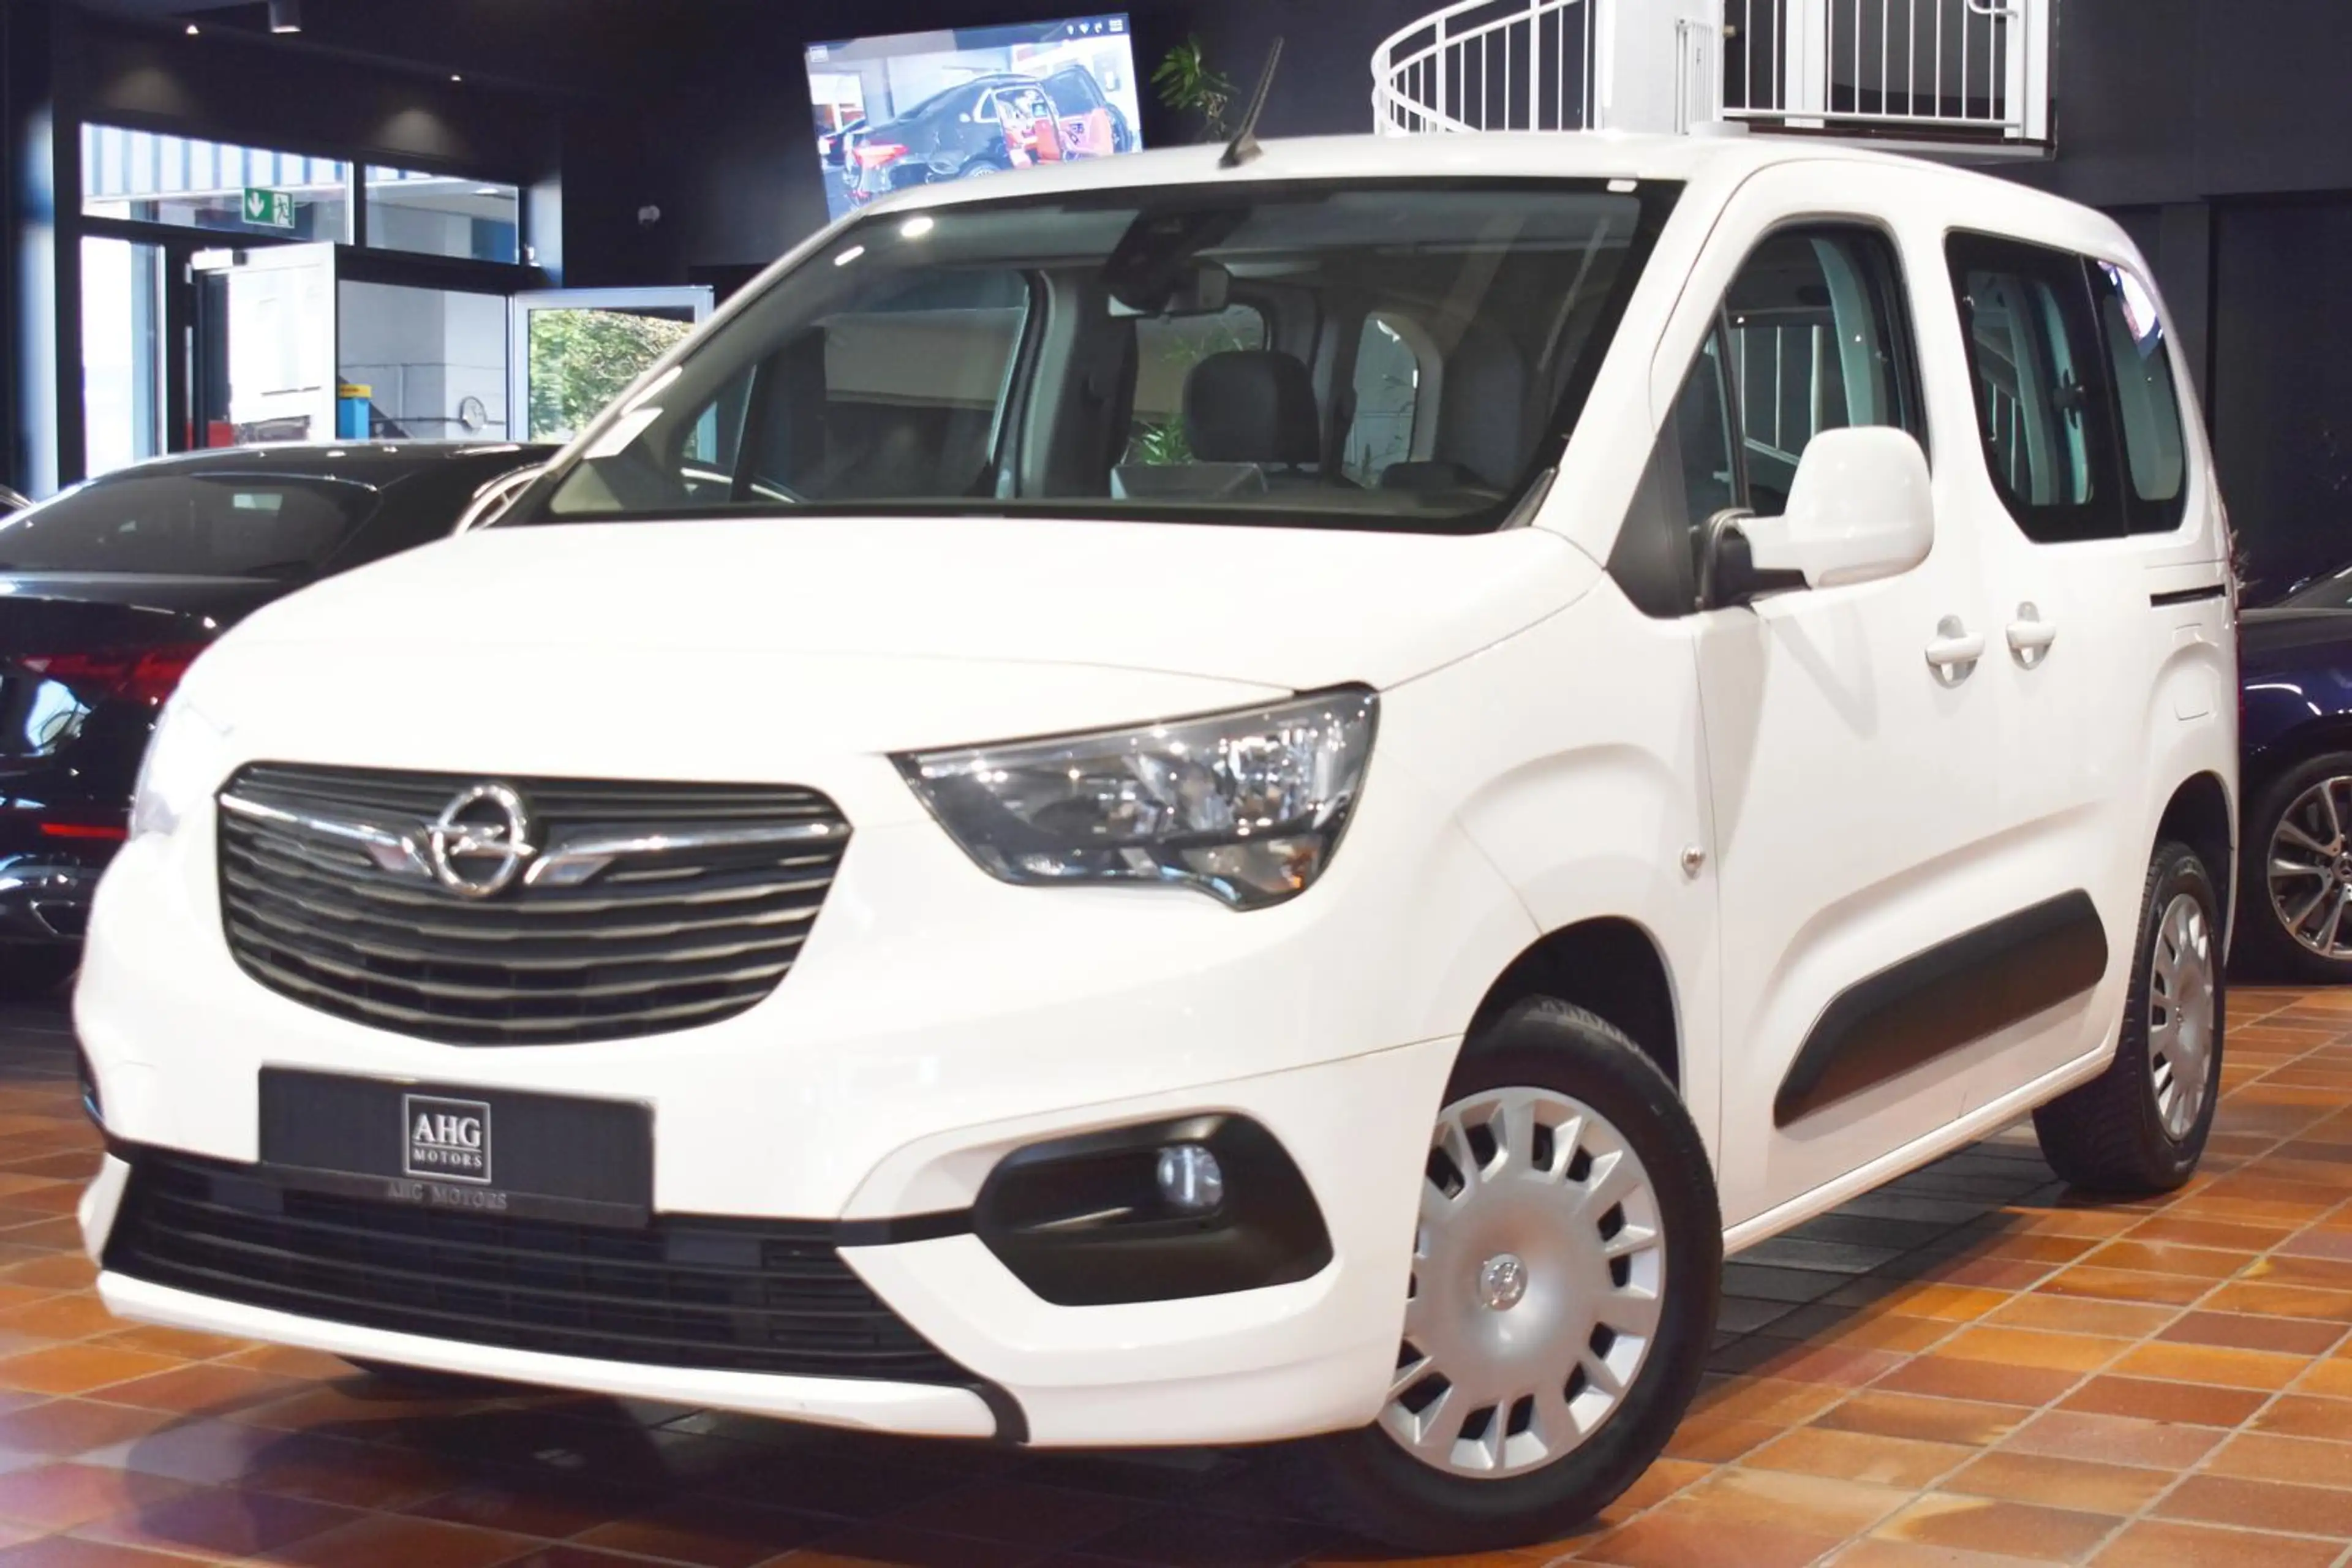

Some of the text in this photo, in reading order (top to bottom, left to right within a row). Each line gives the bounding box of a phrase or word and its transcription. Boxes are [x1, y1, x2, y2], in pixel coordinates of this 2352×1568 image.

[412, 1112, 482, 1148] AHG
[412, 1148, 483, 1168] MOTORS
[431, 1185, 508, 1210] MOTORS
